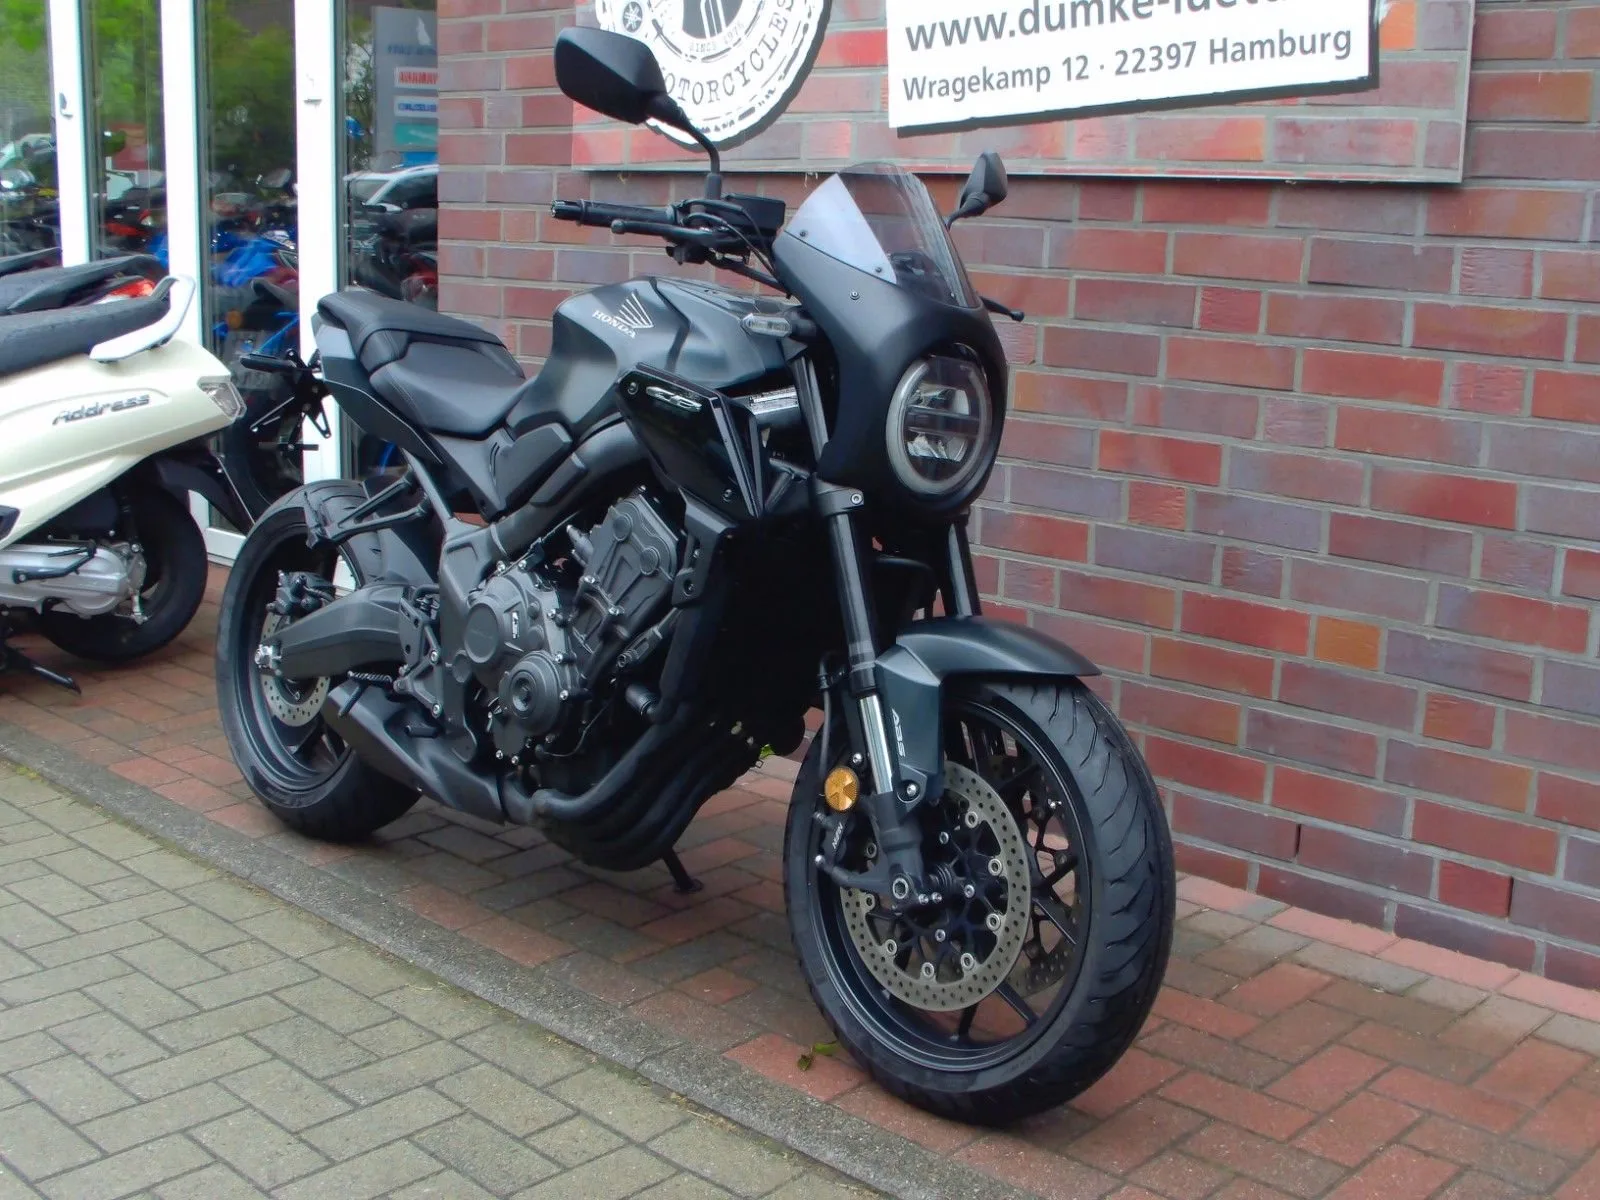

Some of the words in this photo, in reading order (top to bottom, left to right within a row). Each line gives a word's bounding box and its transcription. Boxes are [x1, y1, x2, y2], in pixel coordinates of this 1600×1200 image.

[662, 0, 795, 106] OTORCYCLES
[902, 65, 1051, 102] Wragekamp
[1062, 55, 1089, 81] 12
[1114, 41, 1197, 75] 22397
[1209, 29, 1352, 65] Hamburg
[592, 310, 636, 338] HONDA
[52, 394, 150, 425] Address
